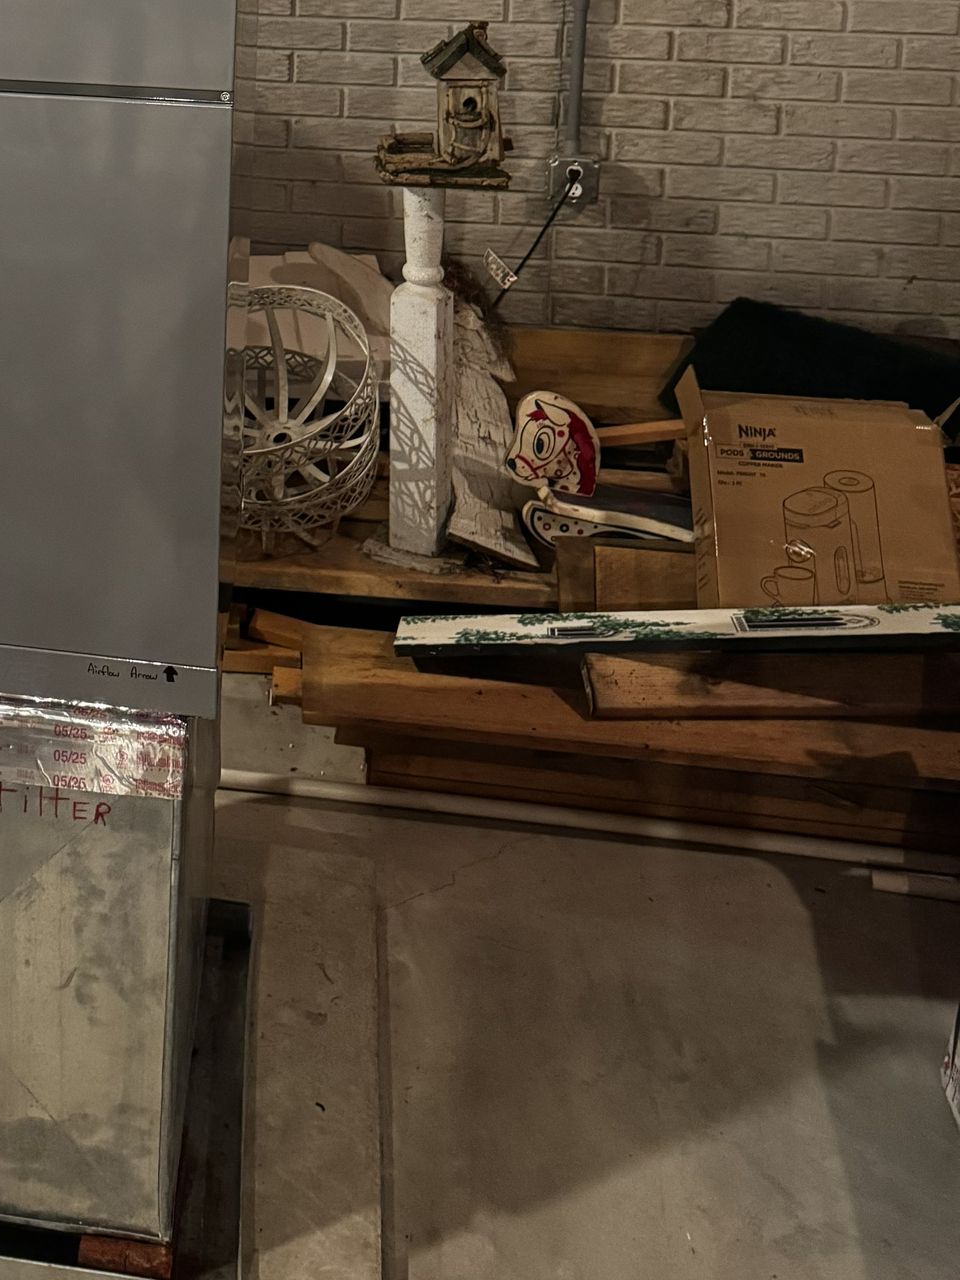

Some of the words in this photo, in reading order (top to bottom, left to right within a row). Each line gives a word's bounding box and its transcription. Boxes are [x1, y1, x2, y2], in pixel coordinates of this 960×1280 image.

[738, 424, 776, 441] NINJA
[720, 448, 744, 456] PODS
[756, 450, 800, 460] GROUNDS
[88, 662, 120, 678] Airflow
[130, 666, 158, 680] Arrow
[53, 749, 88, 764] 05/25
